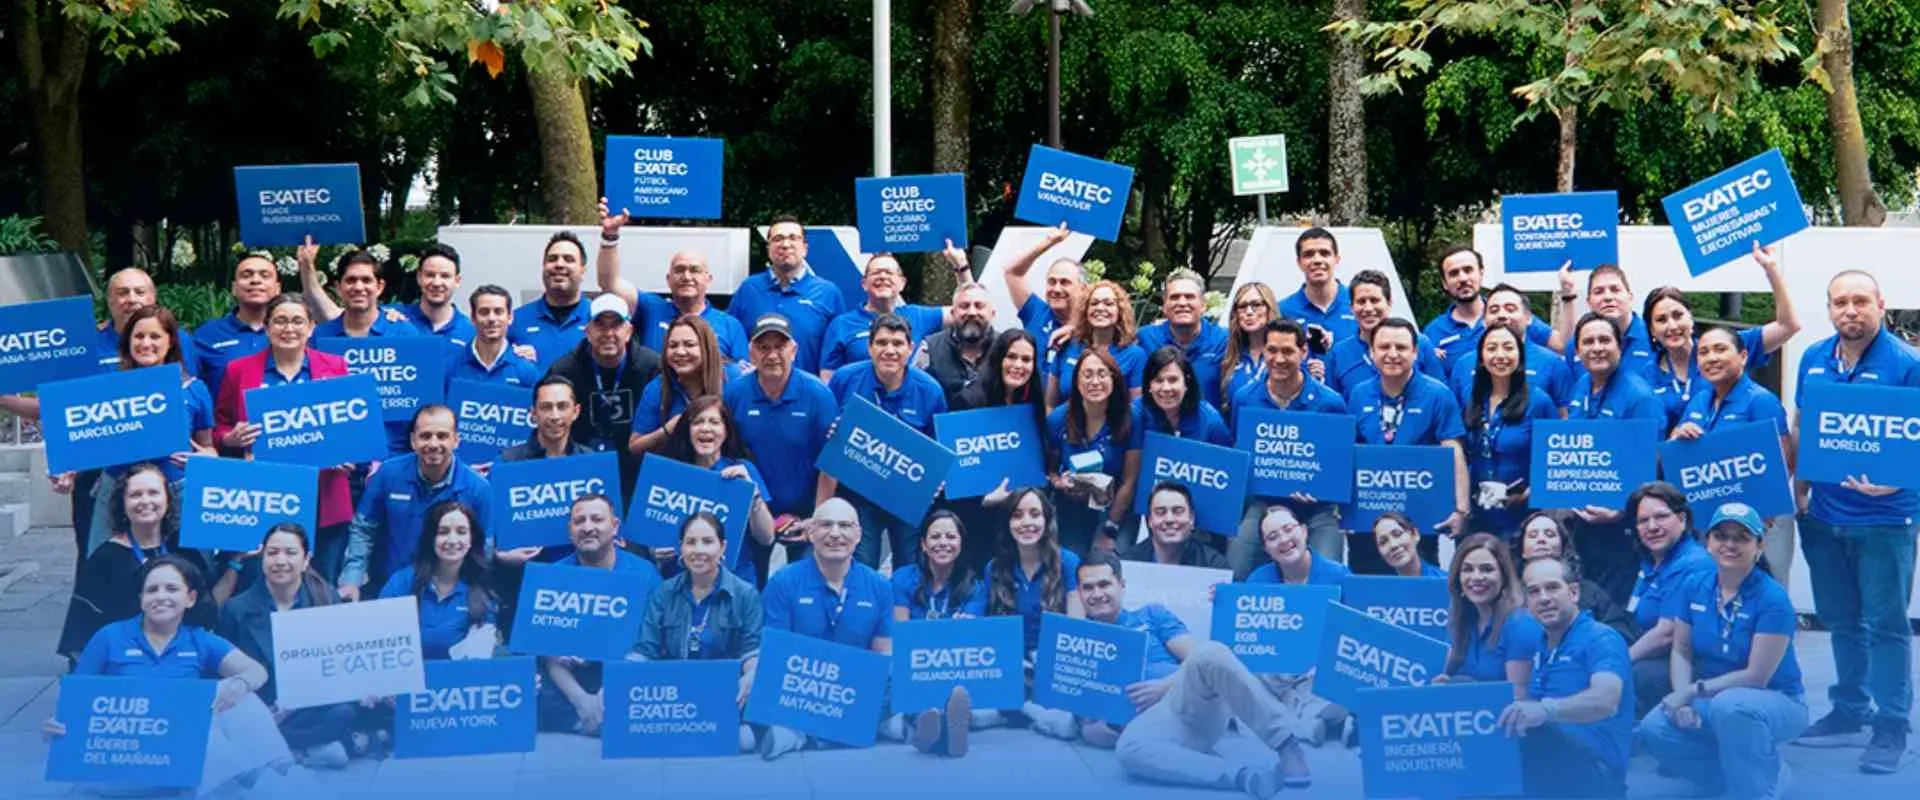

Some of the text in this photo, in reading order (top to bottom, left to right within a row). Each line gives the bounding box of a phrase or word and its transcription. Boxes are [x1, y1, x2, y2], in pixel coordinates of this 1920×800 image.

[634, 148, 673, 161] CLUB
[633, 162, 689, 176] EXATEC
[260, 188, 331, 205] EXATEC
[634, 186, 689, 196] AMERICANO
[881, 186, 920, 199] CLUB
[1040, 171, 1112, 204] EXATEC
[1682, 169, 1772, 221] EXATEC
[634, 195, 670, 205] TOLUCA
[882, 199, 936, 213] EXATEC
[1037, 191, 1092, 212] VANCOUVER
[262, 213, 342, 224] BUSINESS SCHOOL
[883, 214, 927, 224] CICLISMO
[1513, 213, 1583, 231] EXATEC
[1691, 206, 1740, 234] MUJERES
[1696, 201, 1777, 244] EMPRESARIAS Y
[883, 223, 931, 234] CIUDAD DE
[1700, 222, 1763, 256] EJECUTIVAS
[53, 346, 87, 358] DIEGO
[344, 347, 397, 364] CLUB
[65, 393, 167, 427] EXATEC
[262, 398, 369, 434] EXATEC
[460, 400, 538, 428] EXATEC
[68, 421, 143, 442] BARCELONA
[1256, 422, 1298, 439] CLUB
[1820, 411, 1920, 441] EXATEC
[268, 431, 324, 449] FRANCIA
[496, 437, 508, 447] DE
[955, 432, 1021, 455] EXATEC
[1255, 439, 1315, 457] EXATEC
[1548, 434, 1593, 449] CLUB
[1819, 438, 1880, 453] MORELOS
[843, 445, 891, 480] VERACRUZ
[848, 427, 925, 482] EXATEC
[1547, 450, 1611, 466] EXATEC
[1254, 456, 1321, 472] EMPRESARIAL
[1680, 452, 1767, 488] EXATEC
[1155, 457, 1229, 490] EXATEC
[1254, 468, 1314, 482] MONTERREY
[1356, 470, 1433, 490] EXATEC
[1547, 468, 1619, 480] EMPRESARIAL
[509, 478, 605, 507] EXATEC
[1546, 479, 1622, 492] REGIÓN CDMX
[1686, 482, 1743, 503] CAMPECHE
[202, 486, 300, 516] EXATEC
[648, 485, 729, 523] EXATEC
[1358, 490, 1407, 501] RECURSOS
[512, 506, 570, 522] ALEMANIA
[1358, 501, 1405, 511] HUMANOS
[201, 512, 258, 526] CHICAGO
[645, 507, 679, 525] STEAM
[534, 589, 628, 618] EXATEC
[1236, 595, 1285, 612] CLUB
[532, 614, 580, 629] DETROIT
[1235, 613, 1303, 630] EXATEC
[1367, 606, 1448, 627] EXATEC
[279, 635, 412, 661] ORGULLOSAMENTE
[1056, 633, 1117, 661] EXATEC
[1234, 644, 1279, 656] GLOBAL
[911, 647, 996, 669] EXATEC
[1337, 634, 1427, 687] EXATEC
[787, 655, 840, 681] CLUB
[911, 668, 1003, 681] AGUASCALIENTES
[1334, 660, 1390, 688] SINGAPUR
[629, 686, 678, 702] CLUB
[782, 673, 856, 705] EXATEC
[92, 695, 150, 715] CLUB
[410, 684, 522, 713] EXATEC
[779, 694, 844, 719] NATACIÓN
[629, 703, 697, 720] EXATEC
[88, 716, 168, 736] EXATEC
[410, 714, 497, 730] NUEVA YORK
[629, 721, 717, 734] INVESTIGACIÓN
[1381, 710, 1495, 739] EXATEC
[86, 736, 140, 751] LÍDERES
[1384, 739, 1462, 757] INGENIERÍA
[83, 751, 171, 766] DEL MAÑANA
[1385, 757, 1465, 772] INDUSTRIAL
